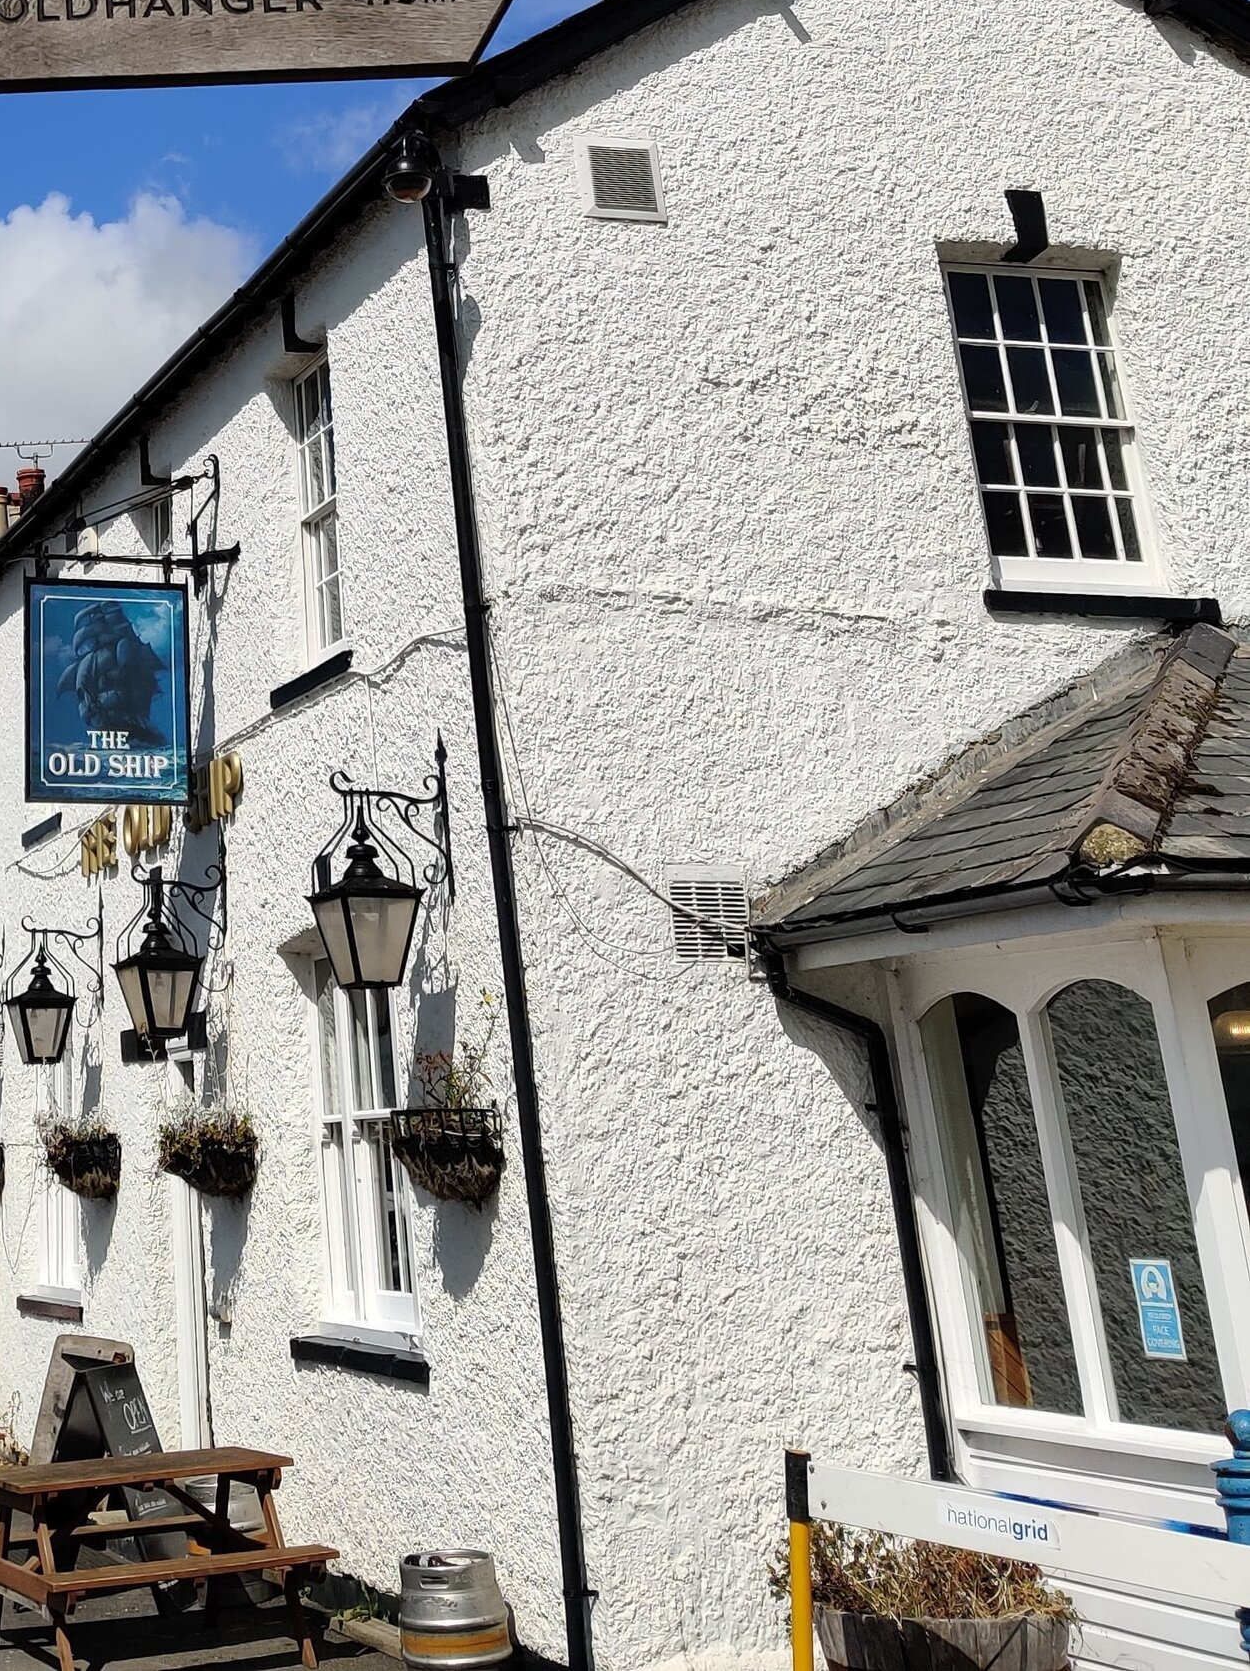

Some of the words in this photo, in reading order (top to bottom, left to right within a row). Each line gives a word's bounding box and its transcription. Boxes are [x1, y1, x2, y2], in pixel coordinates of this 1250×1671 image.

[86, 730, 131, 750] THE
[48, 752, 102, 777] OLD
[107, 754, 169, 779] SHIP
[1152, 1324, 1171, 1336] FACE
[123, 1395, 150, 1430] OPEN
[947, 1507, 1049, 1541] nationalgrid
